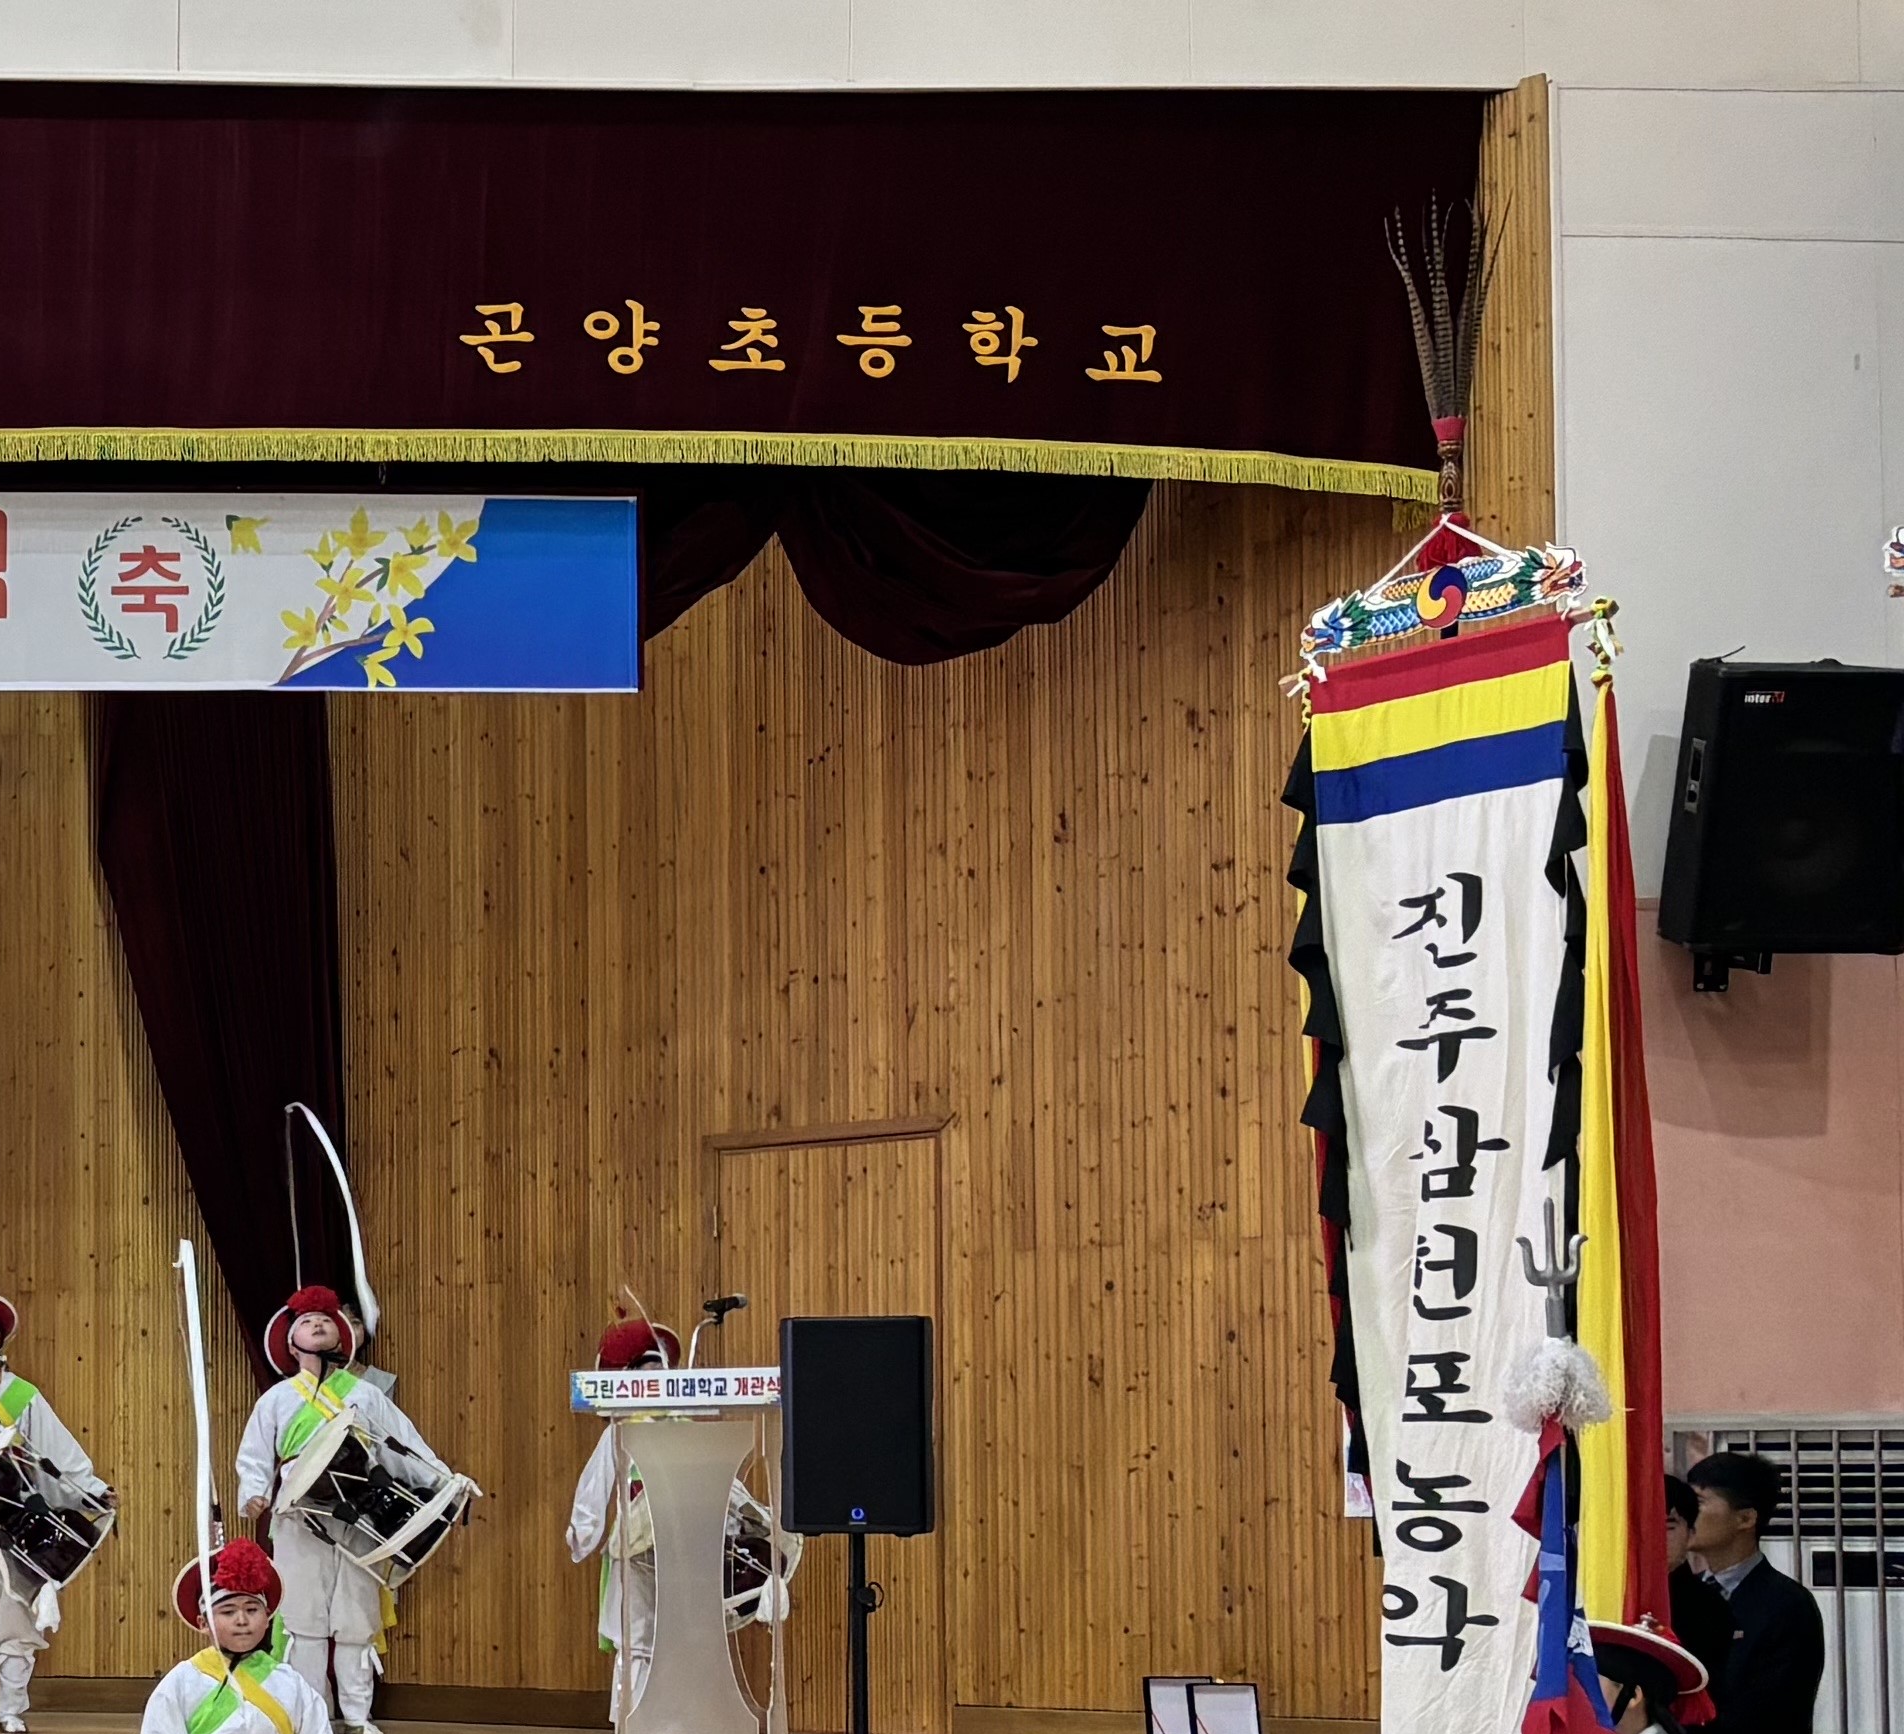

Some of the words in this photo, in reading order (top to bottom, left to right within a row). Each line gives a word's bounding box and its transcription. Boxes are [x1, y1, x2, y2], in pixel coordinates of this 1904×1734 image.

[459, 299, 1164, 384] 곤양초등학교
[109, 544, 191, 634] 축
[584, 1377, 661, 1399] 그린스마트
[666, 1376, 728, 1398] 미래학교
[733, 1376, 781, 1396] 개관식
